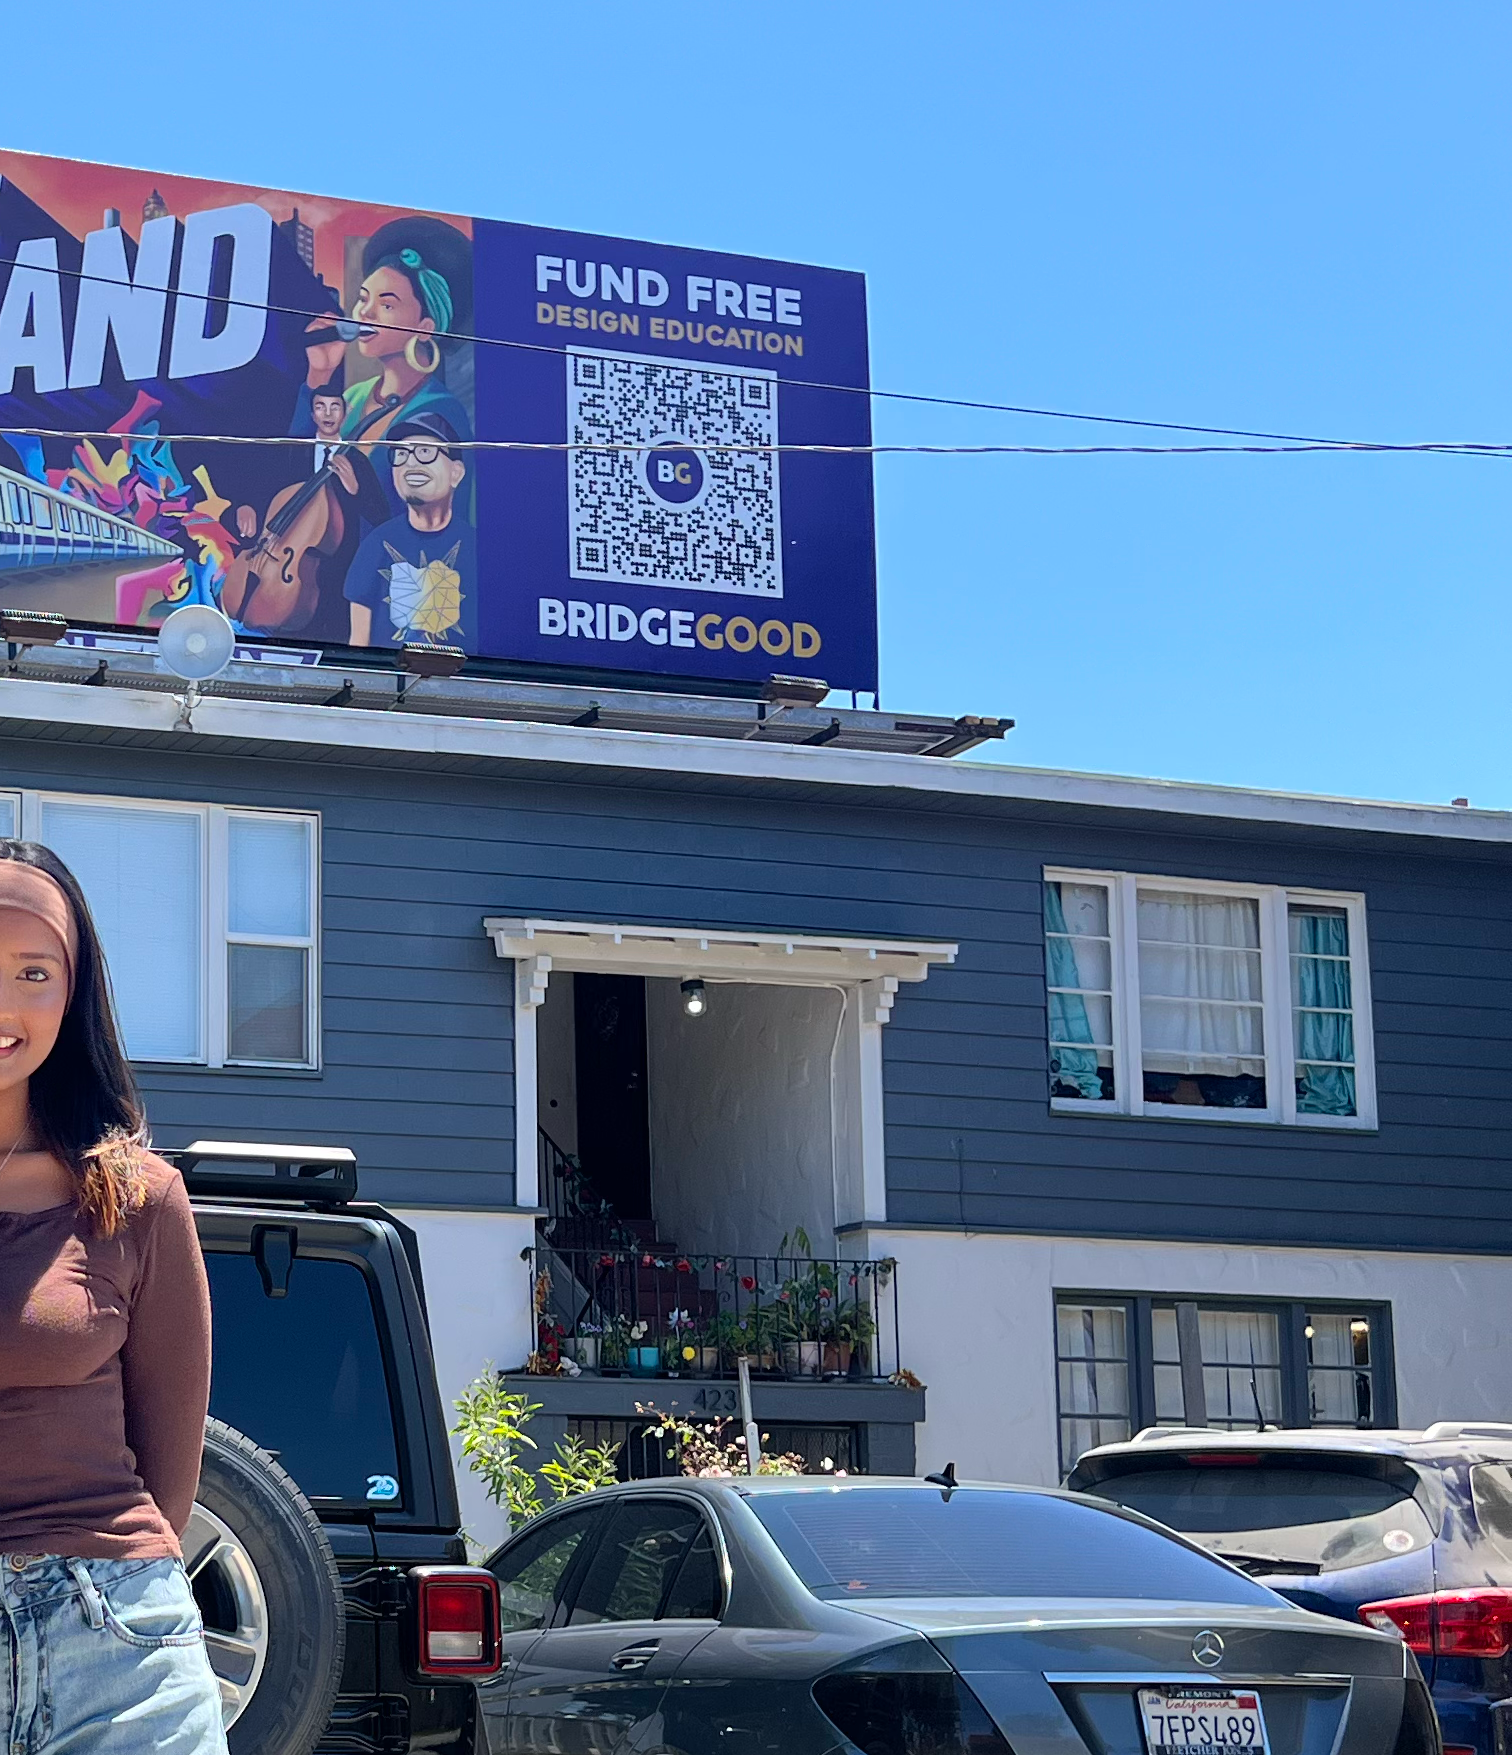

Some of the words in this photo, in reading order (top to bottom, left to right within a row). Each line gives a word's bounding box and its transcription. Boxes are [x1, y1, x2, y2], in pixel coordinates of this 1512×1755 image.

[536, 254, 670, 307] FUND
[687, 275, 802, 327] FREE
[536, 301, 639, 336] DESIGN
[649, 316, 804, 357] EDUCATION
[657, 459, 692, 485] BG
[538, 597, 822, 659] BRIDGEGOOD
[693, 1388, 737, 1411] 423
[1165, 1699, 1231, 1713] California
[1152, 1716, 1256, 1745] 7FPS489
